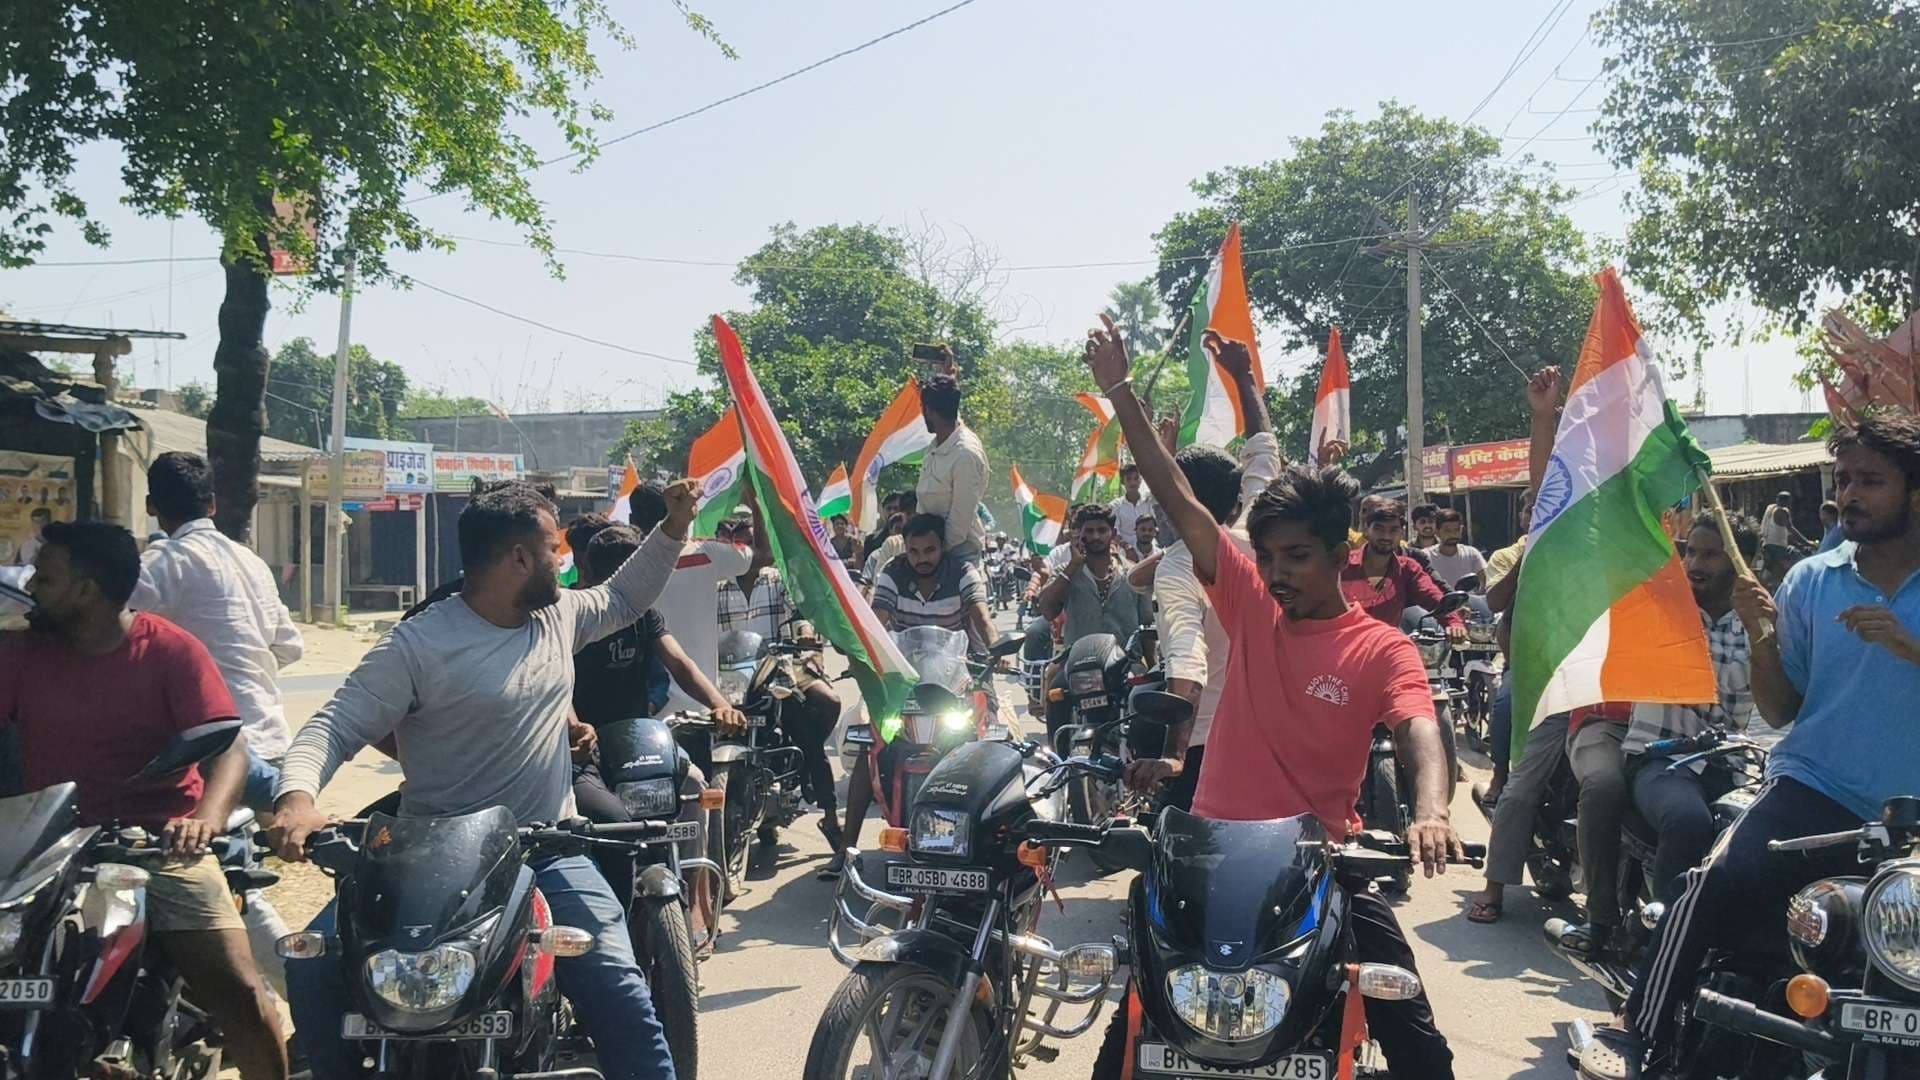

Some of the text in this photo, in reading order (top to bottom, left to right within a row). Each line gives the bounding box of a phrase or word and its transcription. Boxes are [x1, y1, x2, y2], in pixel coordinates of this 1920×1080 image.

[1305, 675, 1324, 696] ENJOY
[1327, 674, 1344, 687] THE
[952, 873, 986, 889] 4688
[0, 981, 49, 1000] 2050
[1865, 1009, 1893, 1031] BR
